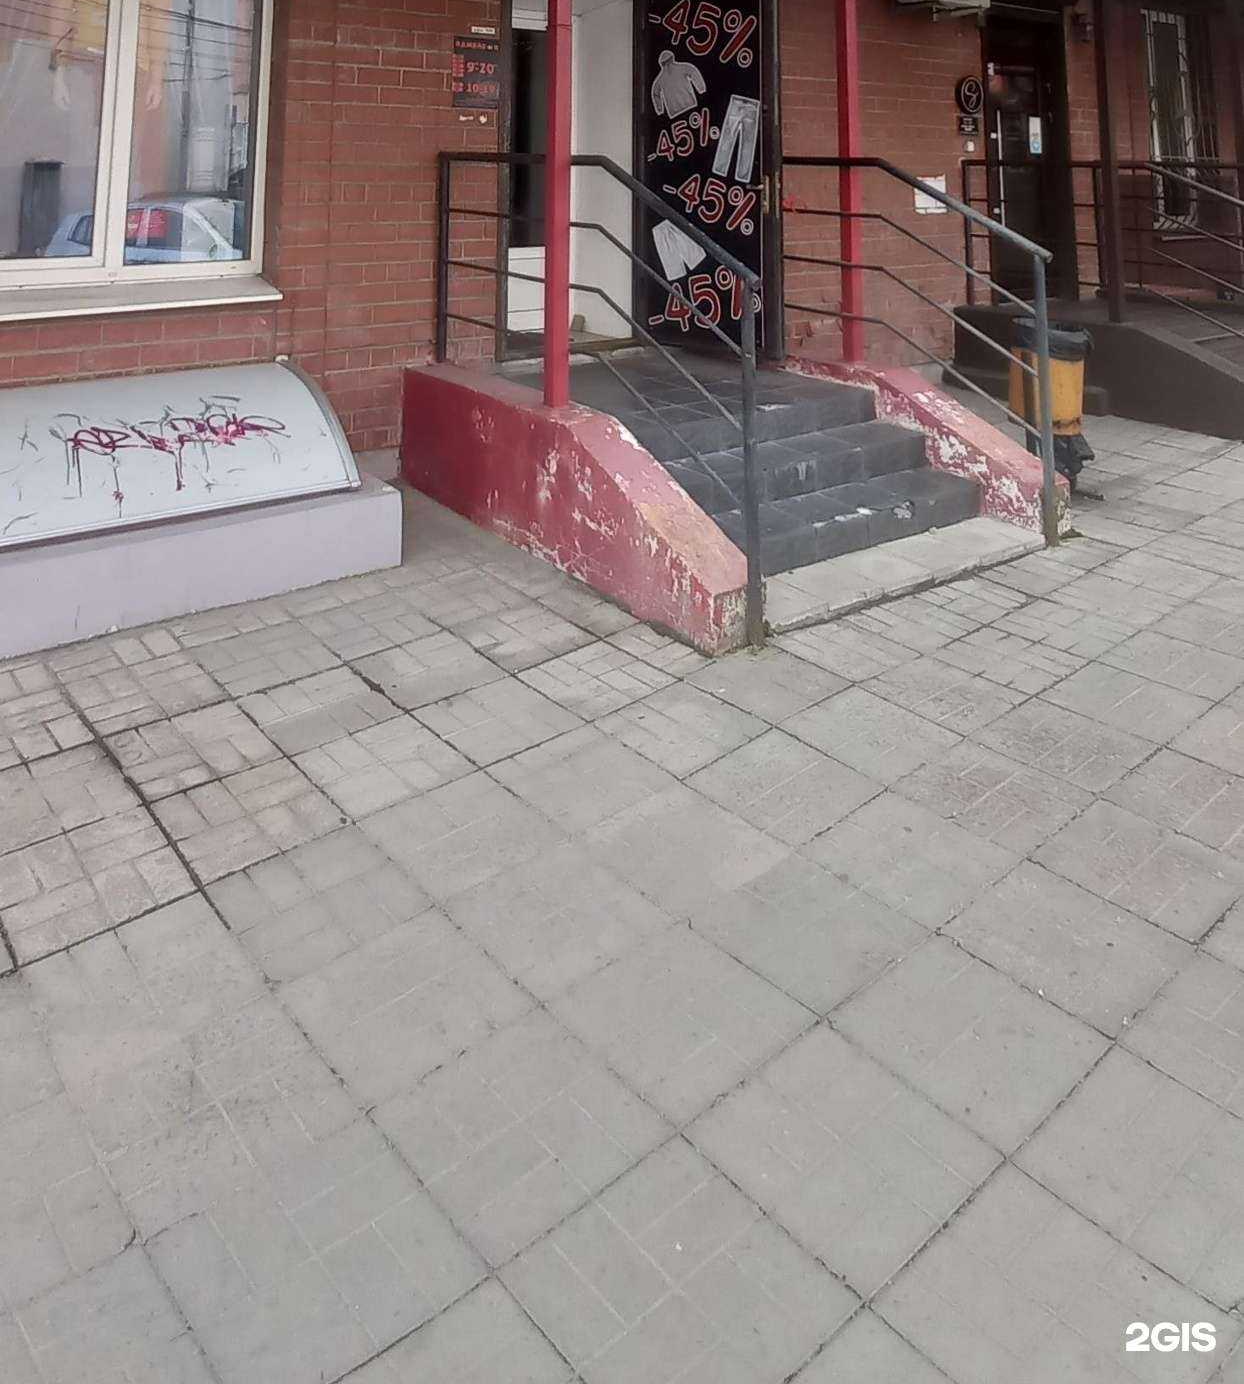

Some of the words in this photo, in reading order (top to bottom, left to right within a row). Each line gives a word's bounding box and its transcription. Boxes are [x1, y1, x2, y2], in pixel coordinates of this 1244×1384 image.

[648, 108, 720, 162] -45%
[663, 173, 754, 235] -45%
[648, 264, 761, 331] -45%
